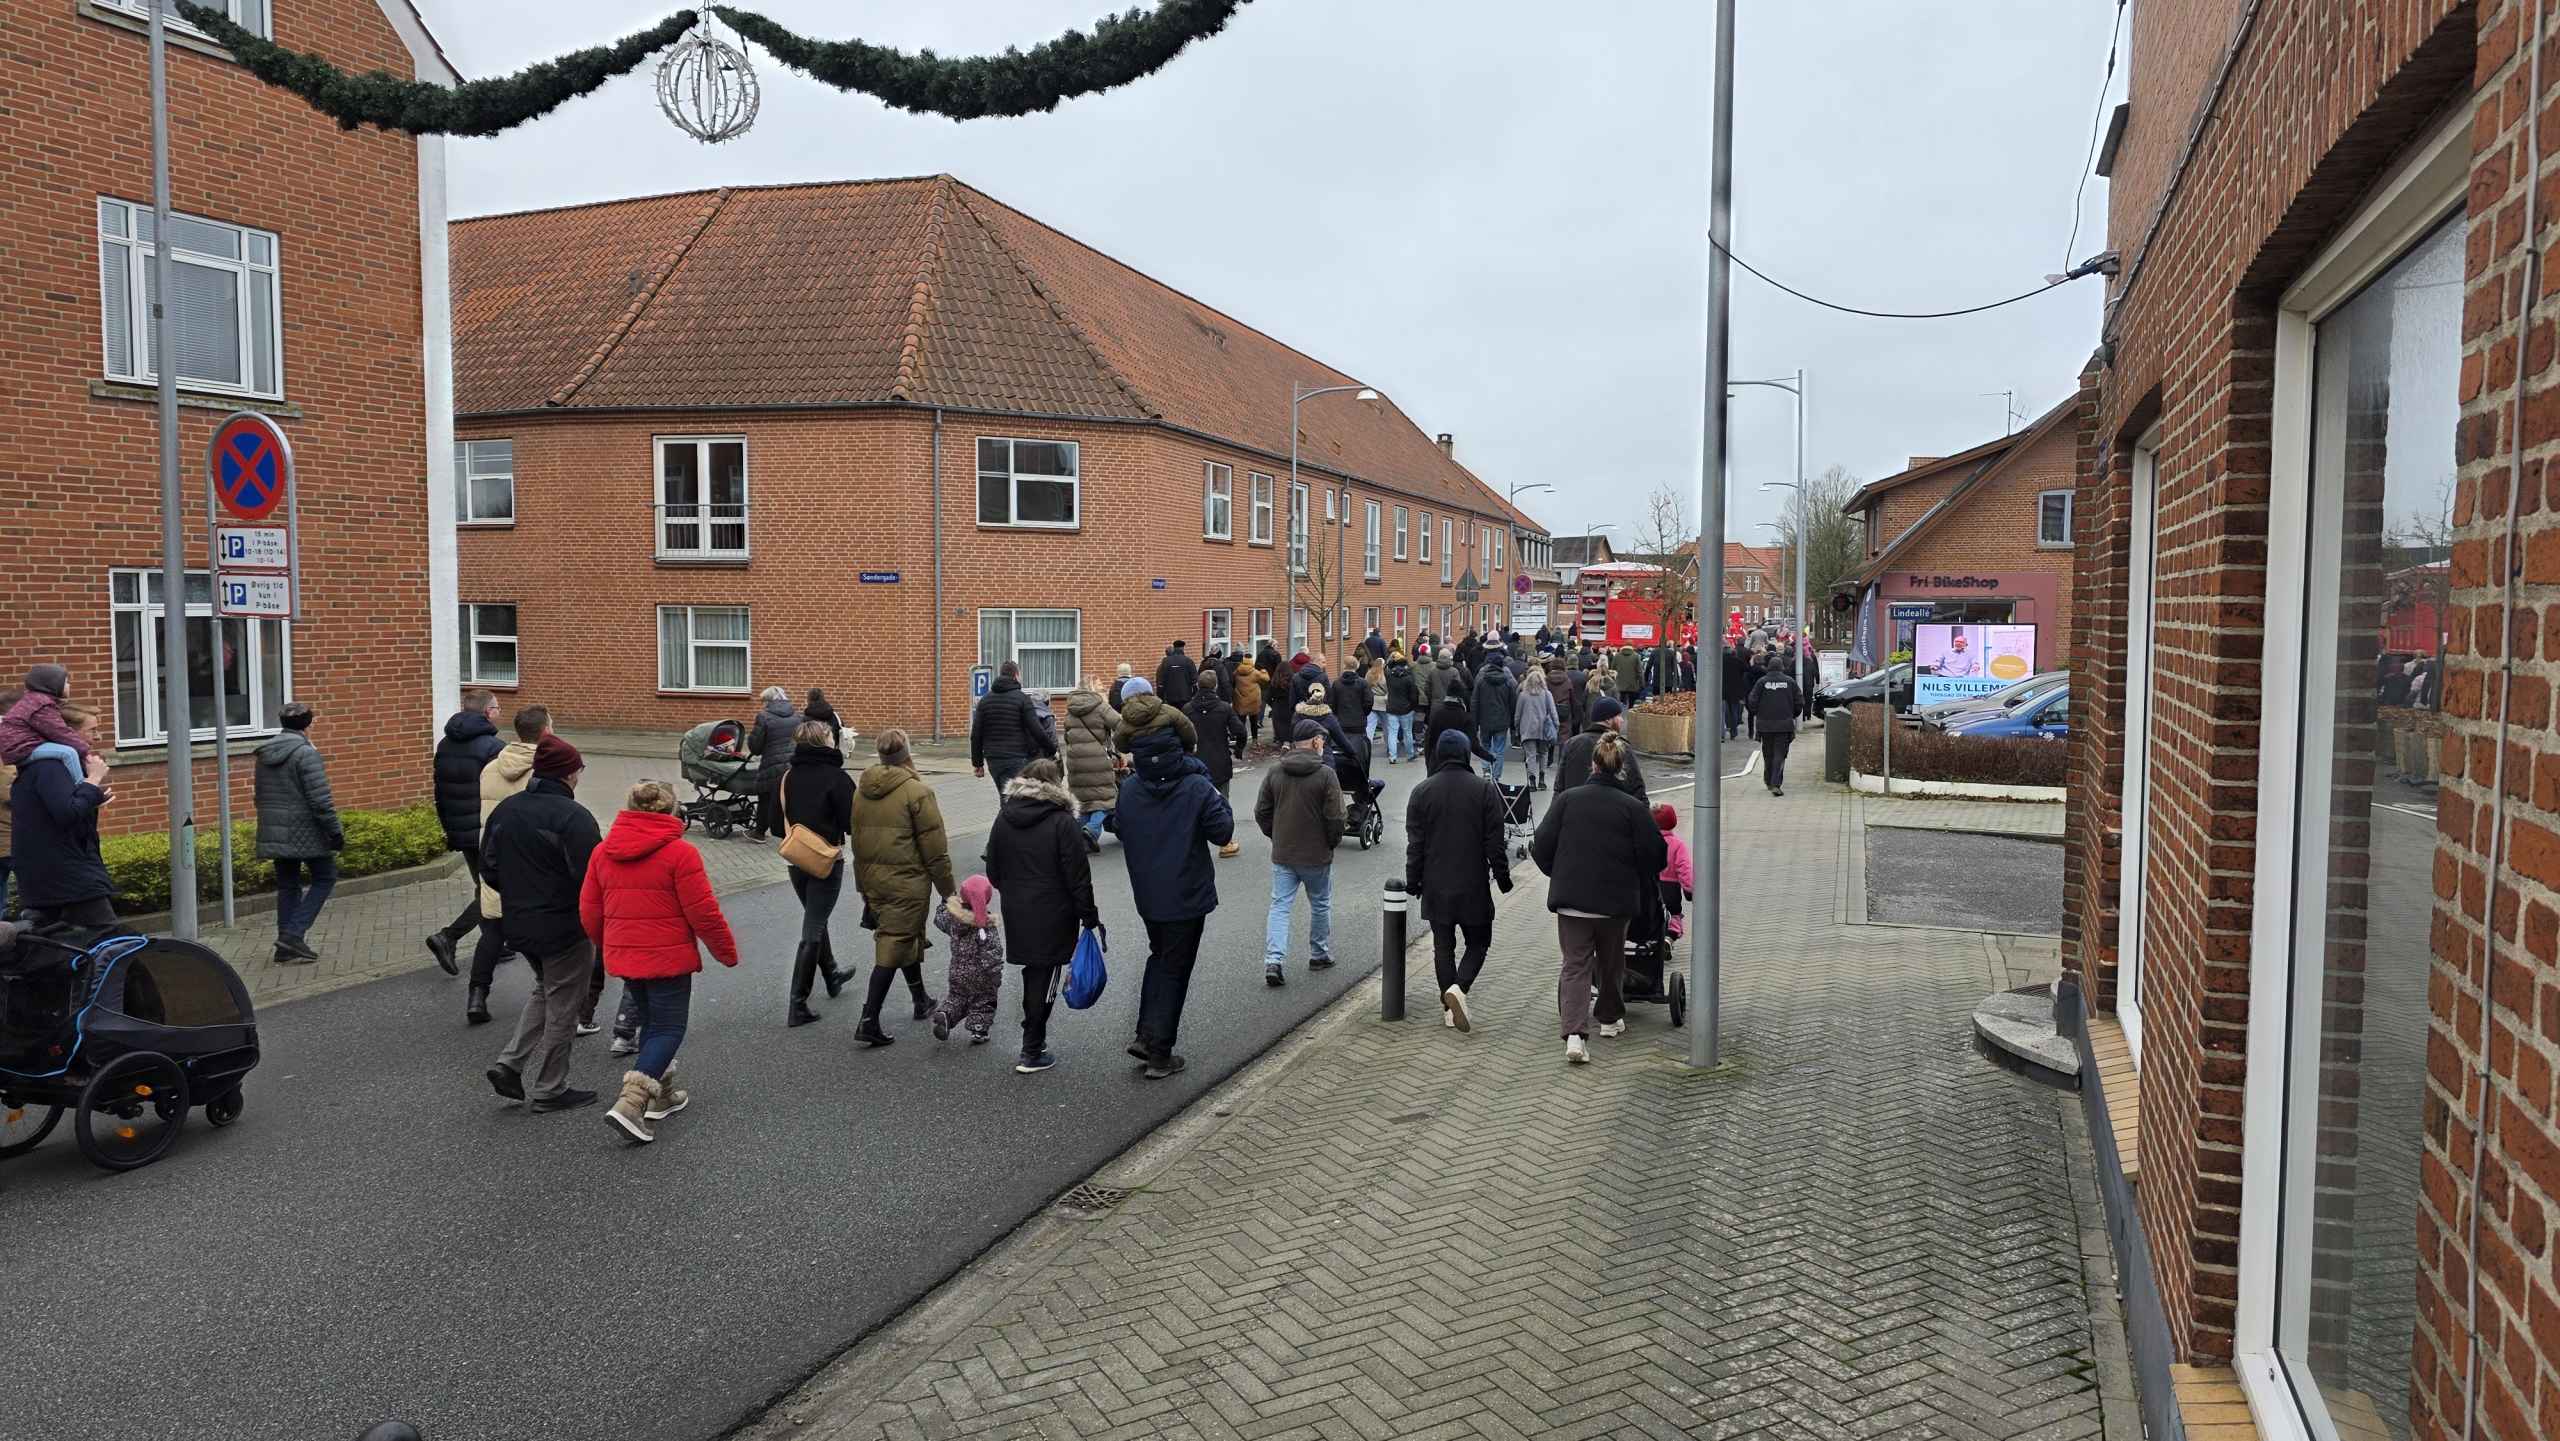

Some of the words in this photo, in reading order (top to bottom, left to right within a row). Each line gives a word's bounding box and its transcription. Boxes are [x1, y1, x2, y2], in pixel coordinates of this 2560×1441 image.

[231, 538, 242, 556] P
[1910, 575, 1929, 588] Fri
[1933, 575, 2000, 590] BikeShop
[234, 585, 244, 603] P
[1893, 606, 1930, 617] Lindeallé
[978, 674, 987, 694] P
[1922, 683, 1951, 692] NILS
